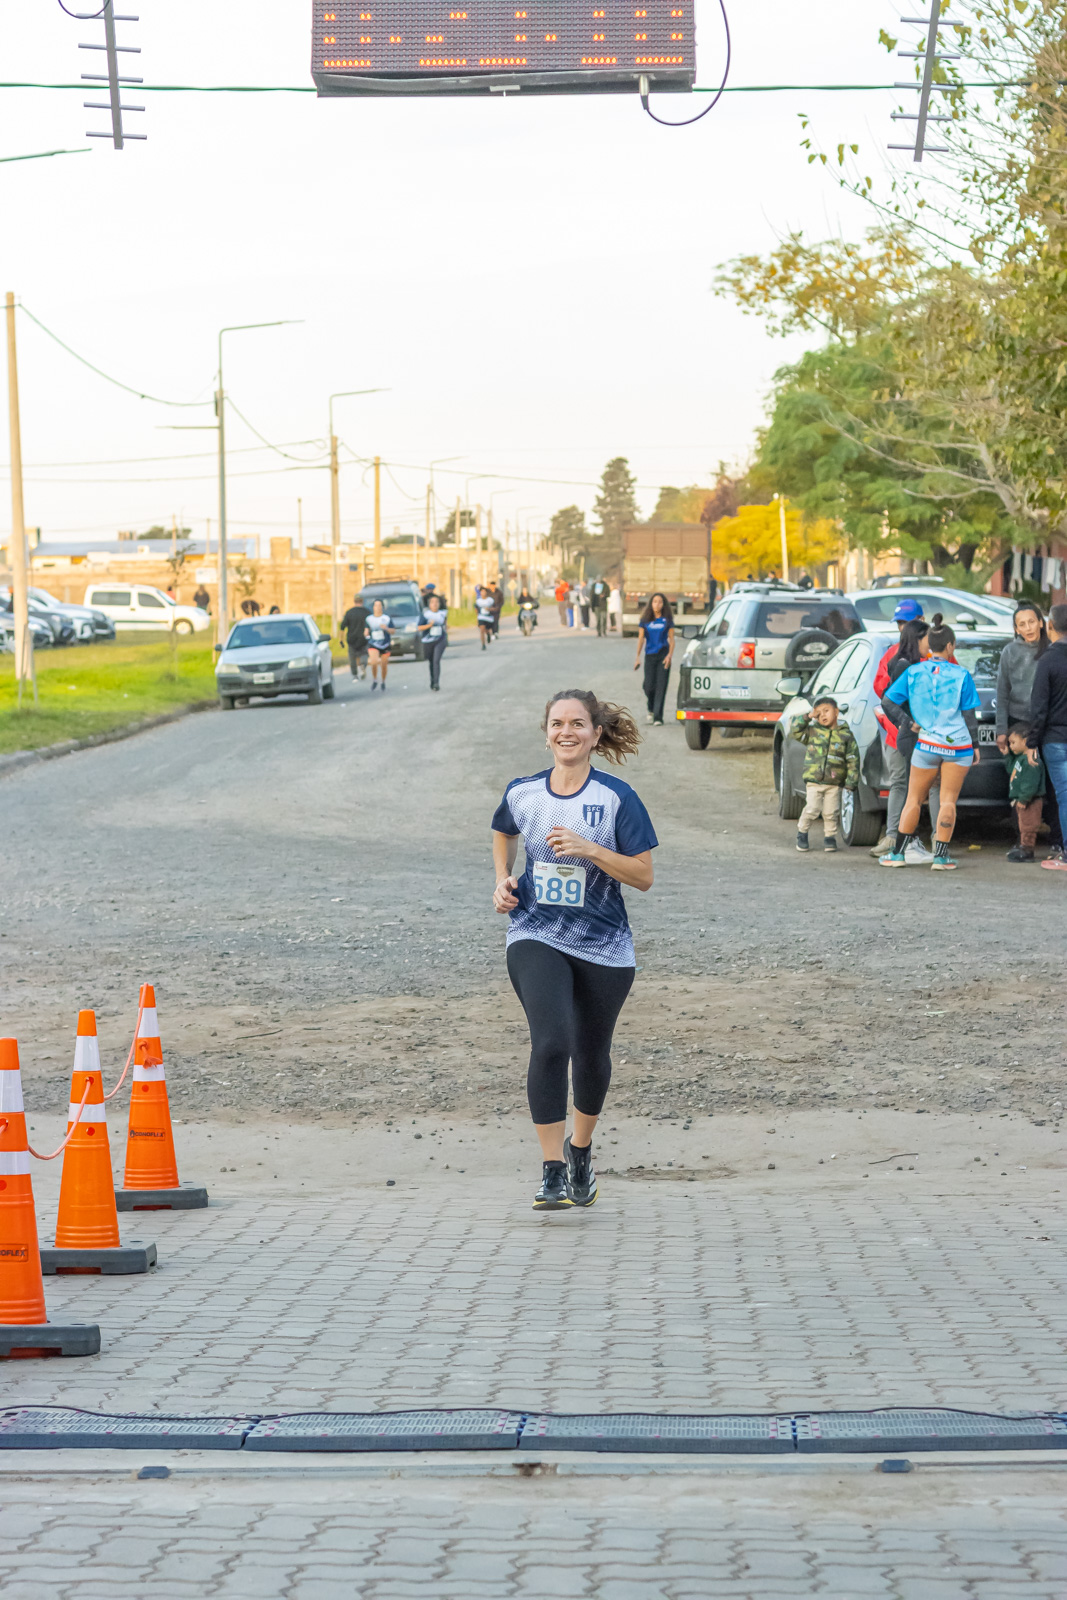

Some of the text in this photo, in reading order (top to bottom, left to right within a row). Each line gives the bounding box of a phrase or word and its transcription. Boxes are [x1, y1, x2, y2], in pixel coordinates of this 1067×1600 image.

[693, 676, 711, 690] 80
[930, 746, 956, 756] LORENZO
[533, 875, 582, 905] 589
